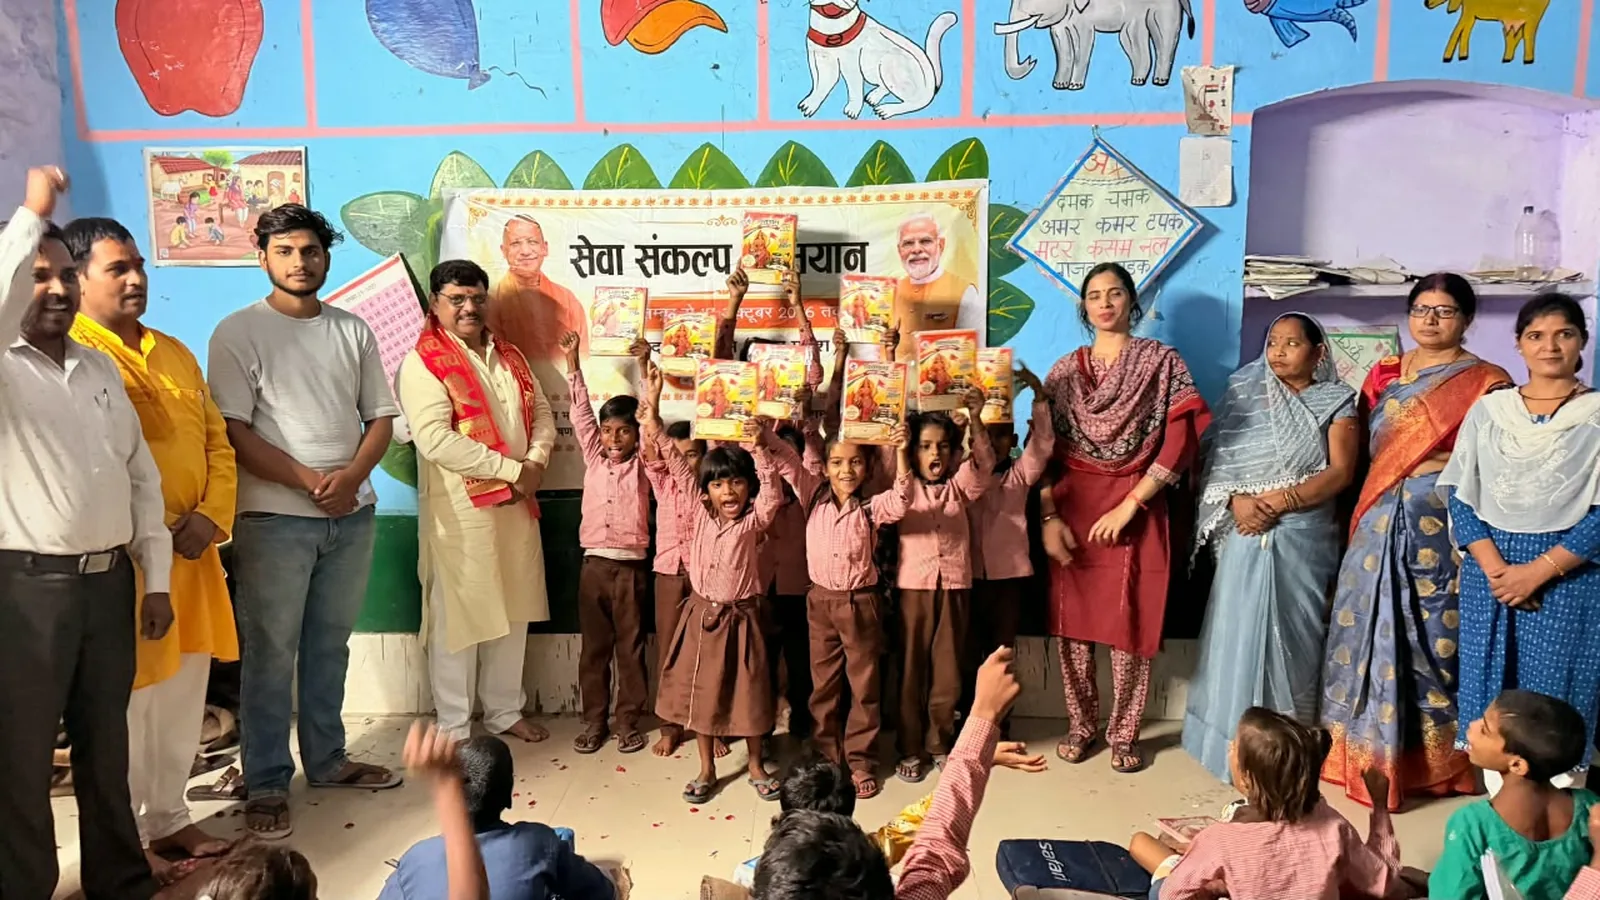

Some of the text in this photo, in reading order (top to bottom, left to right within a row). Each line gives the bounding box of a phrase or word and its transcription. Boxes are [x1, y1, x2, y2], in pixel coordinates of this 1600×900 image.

[1057, 188, 1150, 212] दमक चमक
[1040, 213, 1184, 237] अमर कमर टपक
[569, 234, 625, 278] सेवा
[634, 233, 733, 278] संकल्प
[1034, 237, 1173, 260] मटर कसम नल
[778, 307, 815, 319] 206
[1038, 841, 1071, 882] safari
